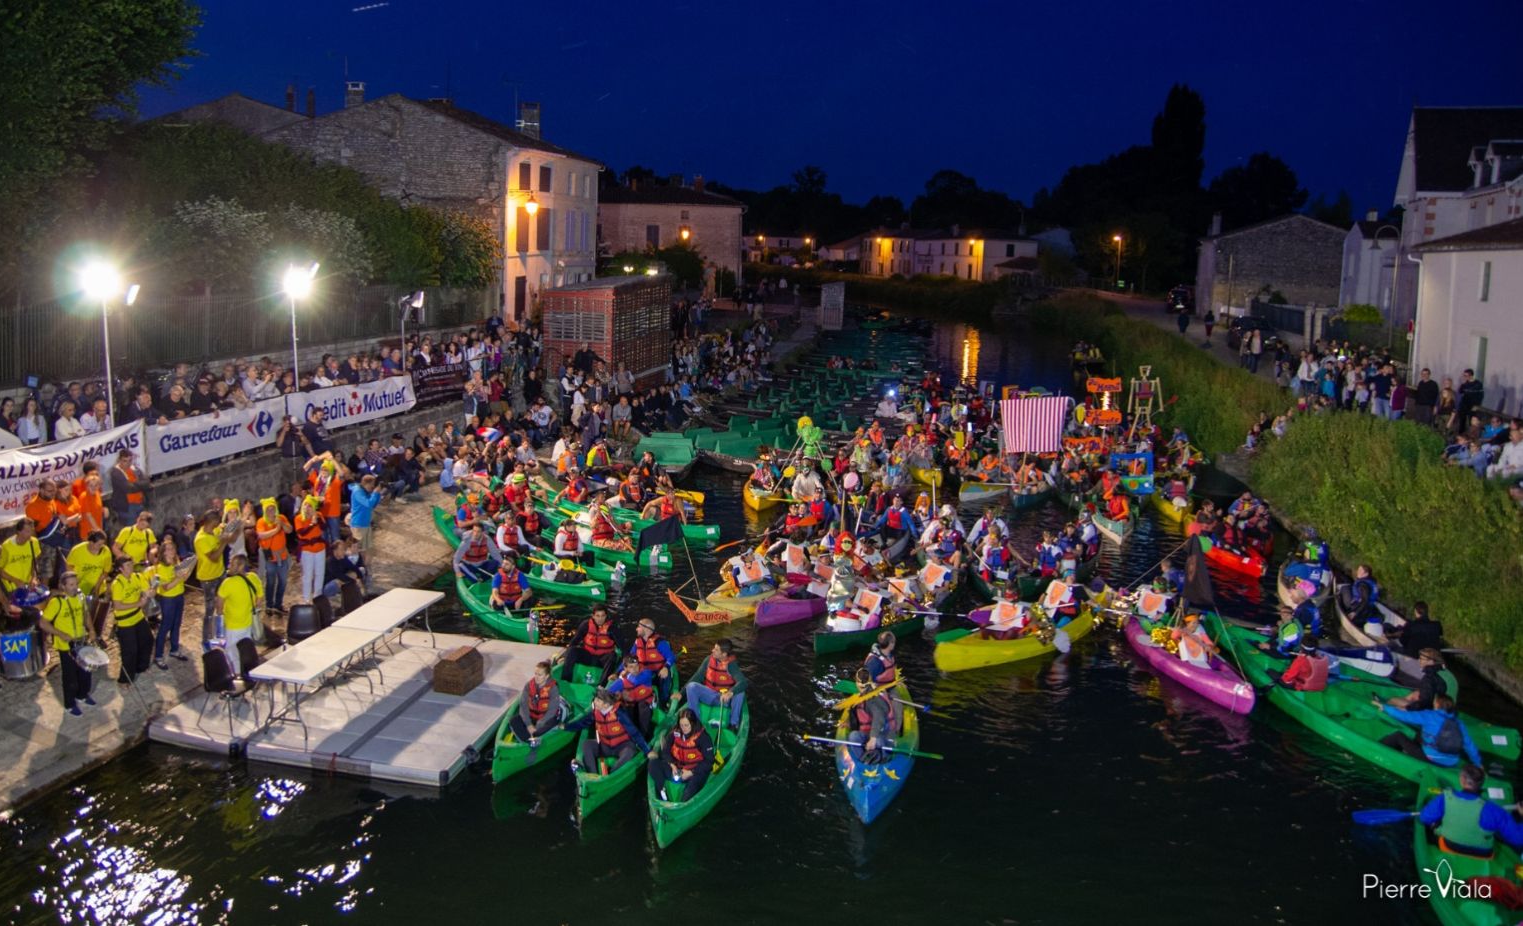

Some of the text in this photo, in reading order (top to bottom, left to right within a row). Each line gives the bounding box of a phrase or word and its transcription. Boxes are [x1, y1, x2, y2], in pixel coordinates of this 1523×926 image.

[305, 397, 347, 421] Cédit
[159, 422, 242, 453] Carrefour
[54, 452, 79, 470] DU
[81, 433, 139, 463] MARAIS
[3, 638, 28, 654] SAM
